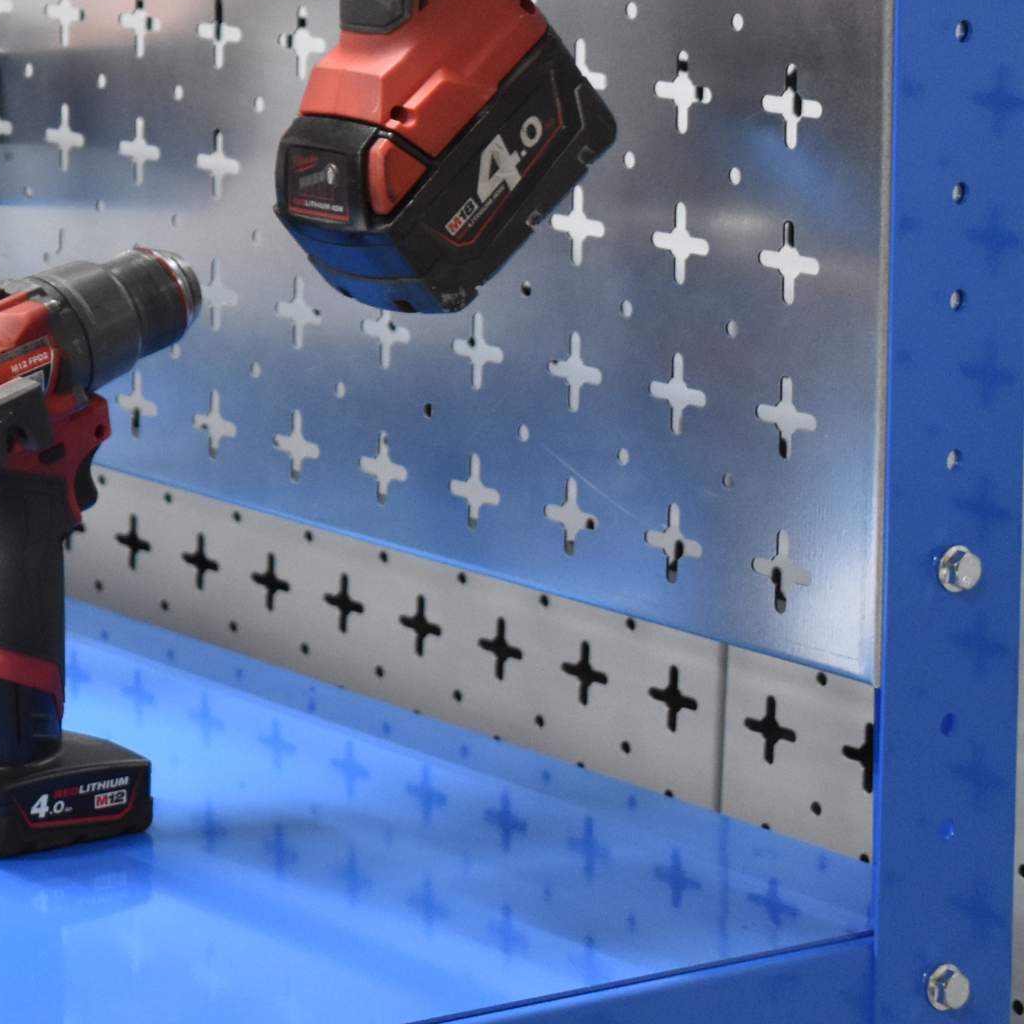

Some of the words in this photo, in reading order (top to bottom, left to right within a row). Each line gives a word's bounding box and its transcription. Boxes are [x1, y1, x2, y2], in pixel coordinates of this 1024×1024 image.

[477, 116, 543, 204] 4.0
[446, 200, 477, 235] M18
[10, 359, 27, 373] M12
[95, 790, 127, 808] M12
